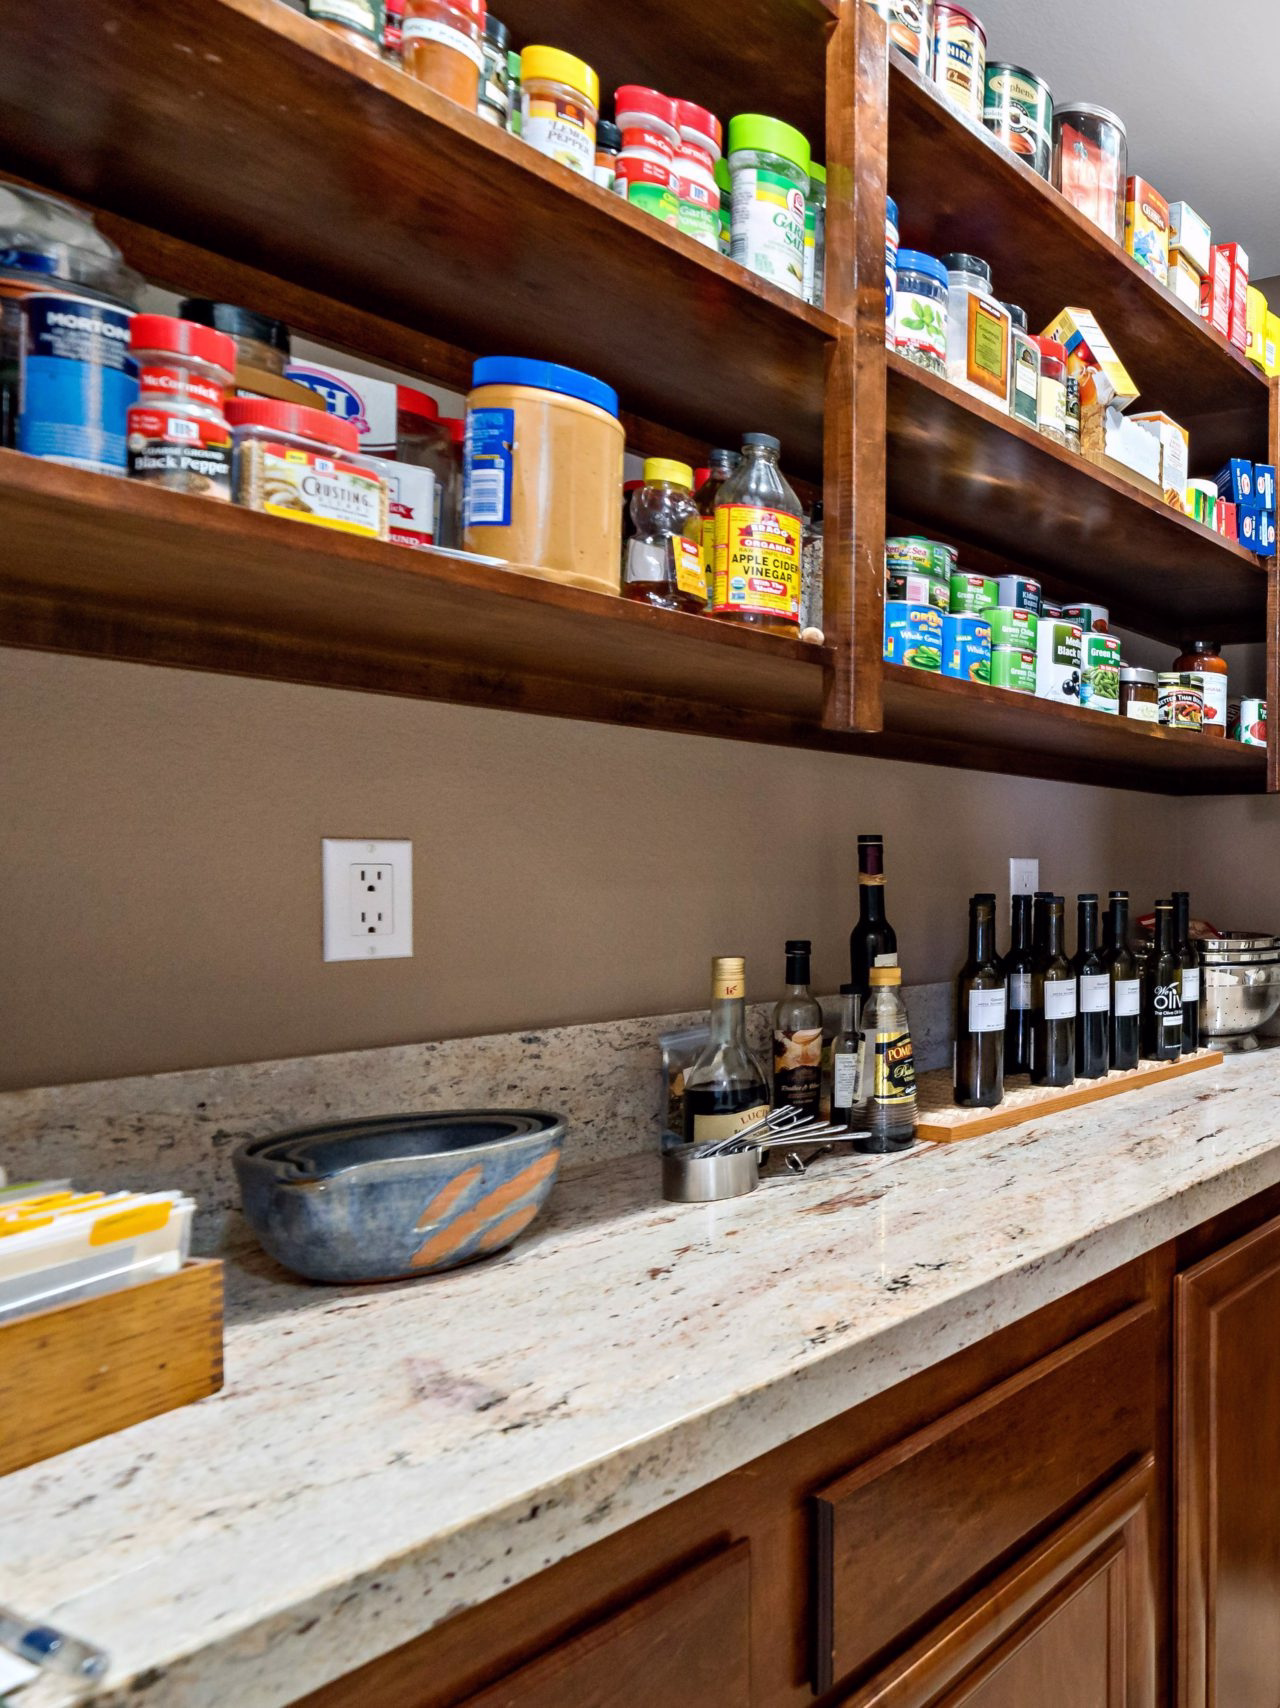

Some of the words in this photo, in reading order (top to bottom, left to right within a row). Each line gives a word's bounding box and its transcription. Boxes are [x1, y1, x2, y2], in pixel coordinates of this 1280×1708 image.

[143, 374, 219, 403] McCormick
[141, 447, 182, 457] COARSE
[183, 447, 225, 460] GROUND
[134, 455, 178, 470] Black
[180, 456, 229, 475] Pepper
[302, 476, 369, 507] CRUSTING
[750, 523, 789, 538] BRAGG
[744, 539, 793, 555] ORGANIC
[912, 547, 927, 556] Sea
[732, 554, 769, 566] APPLE
[772, 558, 798, 574] CIDER
[743, 565, 793, 583] VINEGAR
[956, 591, 974, 599] Green
[1022, 591, 1039, 600] Kidney
[1023, 599, 1038, 608] Beans
[900, 629, 924, 641] Whole
[1001, 625, 1020, 635] Green
[966, 644, 984, 655] Whole
[1057, 645, 1077, 657] Black
[1090, 648, 1111, 658] Green
[1010, 667, 1027, 676] Green
[1177, 694, 1193, 702] THAN
[1154, 985, 1170, 996] We
